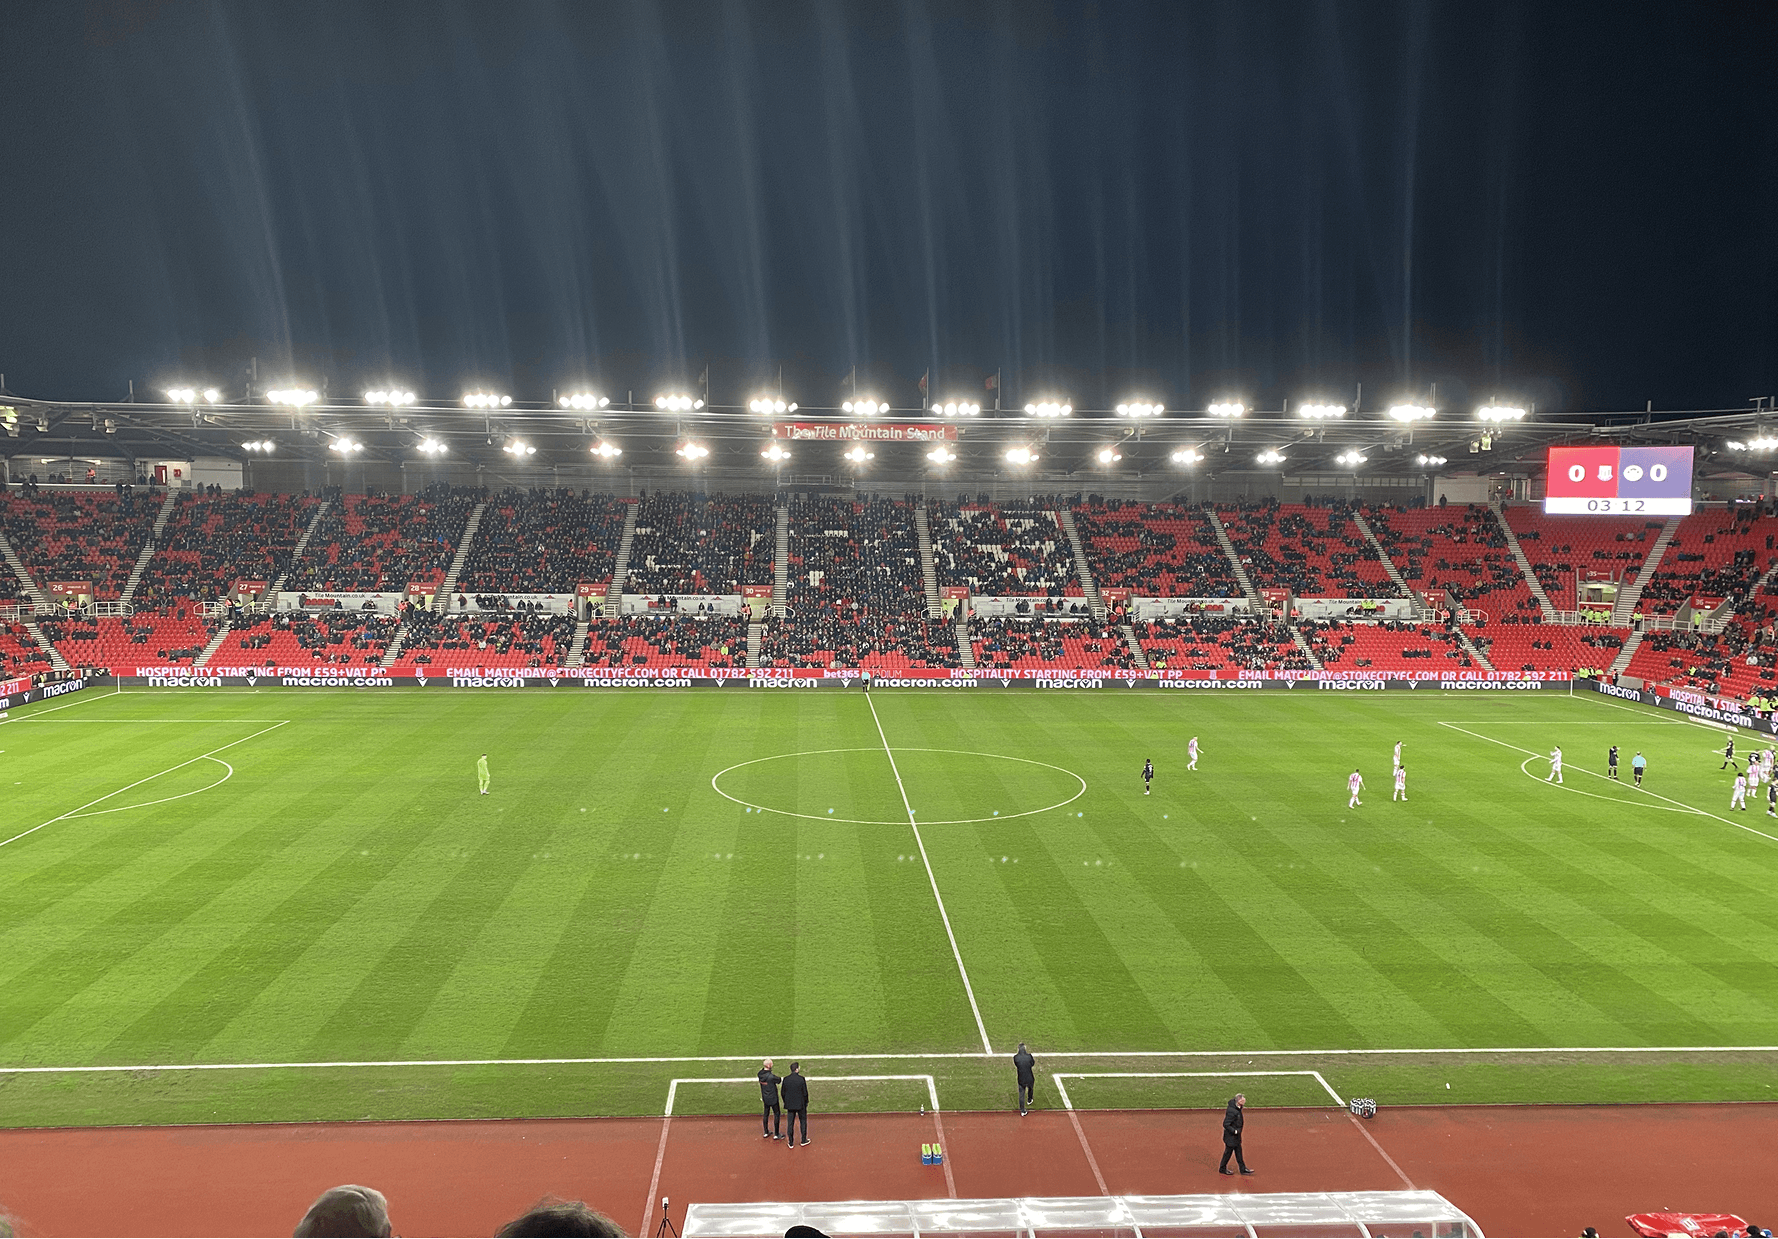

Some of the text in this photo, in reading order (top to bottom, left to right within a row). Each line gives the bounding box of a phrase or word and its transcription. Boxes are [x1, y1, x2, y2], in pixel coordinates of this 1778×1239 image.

[785, 426, 945, 439] The Tile Mountain Stand
[1568, 464, 1667, 482] 0 0
[136, 667, 212, 676] HOSPITALITY
[277, 668, 311, 677] FROM
[314, 668, 368, 677] £59+VAT
[447, 668, 482, 678] EMAIL
[662, 668, 678, 678] OR
[681, 668, 707, 678] CALL
[710, 668, 746, 678] 01782
[750, 669, 772, 678] 592
[775, 669, 793, 678] 211
[824, 669, 902, 678] bet365 TADIUM
[950, 669, 1021, 679] HOSPITALITY
[1024, 670, 1078, 679] STARTING
[1080, 670, 1111, 679] FROM
[1168, 670, 1183, 679] PP
[1238, 671, 1271, 680] EMAIL
[1442, 671, 1454, 680] OR
[1459, 671, 1484, 680] CALL
[1488, 672, 1521, 681] 01782
[1524, 672, 1546, 681] 592
[1550, 672, 1568, 681] 211
[149, 677, 221, 686] macron
[283, 677, 393, 686] macron.com
[453, 678, 524, 687] macron
[584, 678, 692, 688] macron.com
[750, 678, 817, 688] macron
[875, 679, 977, 688] macron.com
[1036, 679, 1102, 688] macron
[1159, 679, 1262, 689] macron.com
[1319, 680, 1385, 690] macron
[1441, 680, 1541, 690] macron.com
[7, 682, 19, 695] 211
[44, 679, 82, 698] macron
[1600, 682, 1640, 701] macron
[1670, 689, 1719, 709] HOSPITALY
[1676, 702, 1752, 727] macron.com
